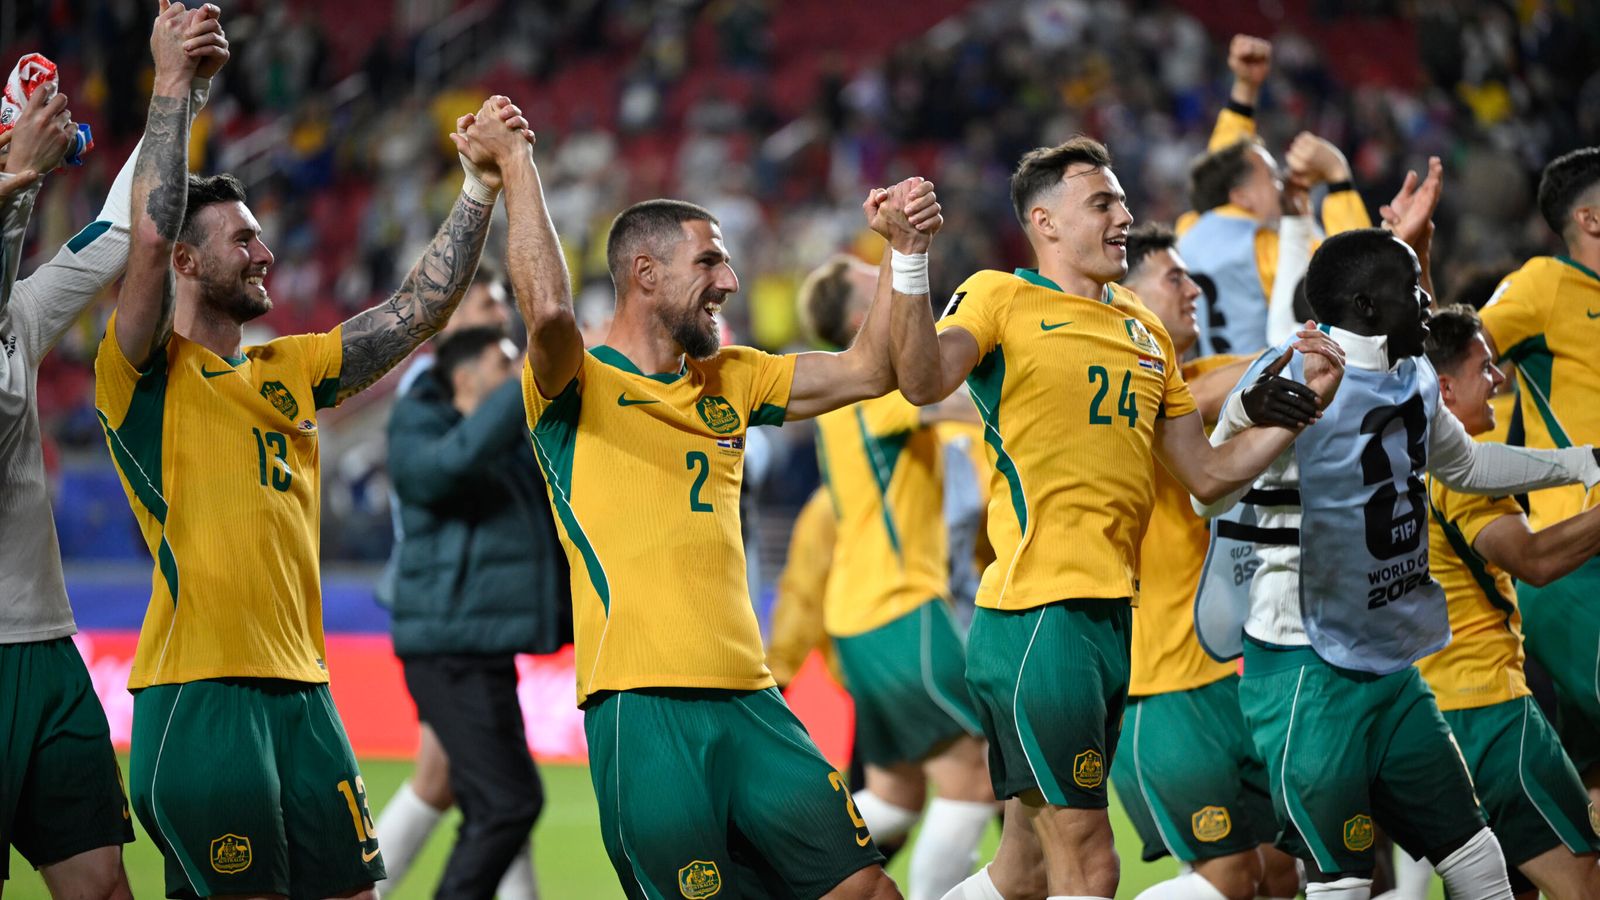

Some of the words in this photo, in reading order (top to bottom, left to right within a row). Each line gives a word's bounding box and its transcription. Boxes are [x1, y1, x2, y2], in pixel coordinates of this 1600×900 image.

[1088, 365, 1138, 428] 24
[252, 427, 292, 492] 13
[686, 451, 713, 512] 2
[1391, 519, 1417, 545] FIFA
[1368, 560, 1414, 585] WORLD
[1368, 568, 1433, 610] 2026
[337, 775, 377, 842] 13
[828, 772, 866, 828] 2
